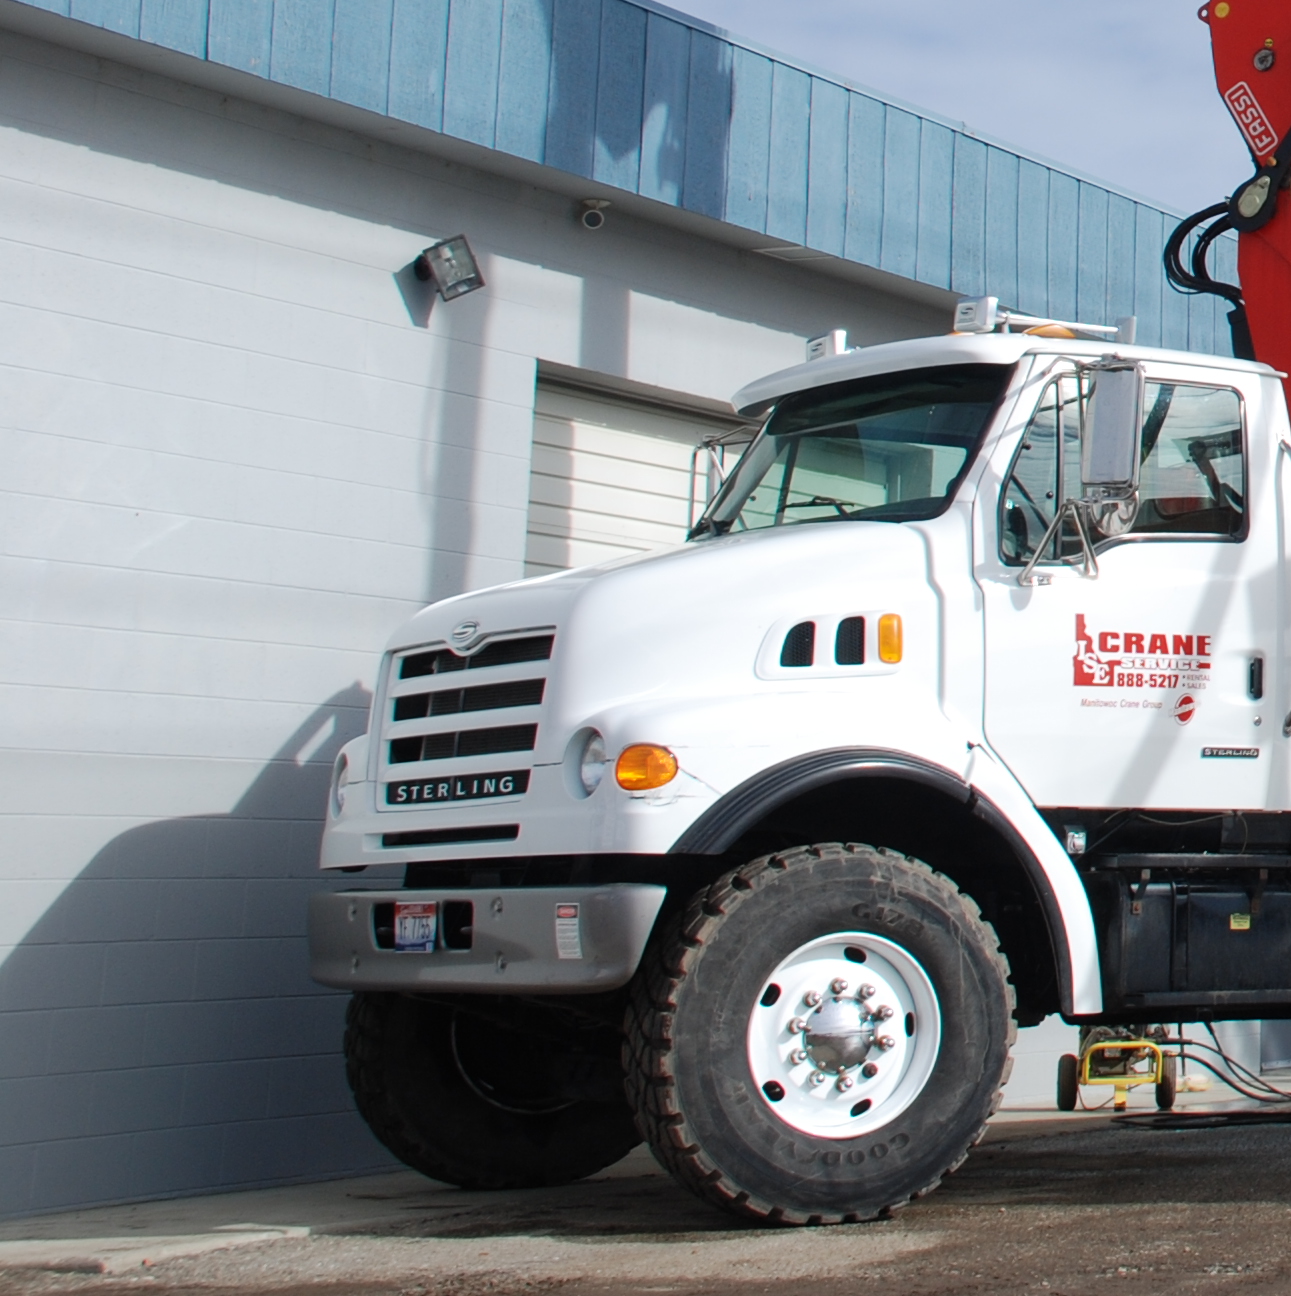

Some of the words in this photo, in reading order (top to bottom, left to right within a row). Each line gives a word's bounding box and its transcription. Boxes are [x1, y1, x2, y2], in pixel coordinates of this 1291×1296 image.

[1229, 88, 1273, 153] FASSI
[1098, 631, 1211, 657] CRANE
[1119, 657, 1201, 672] SERVICE
[1117, 673, 1179, 689] 888-5217
[396, 775, 514, 803] STERLING
